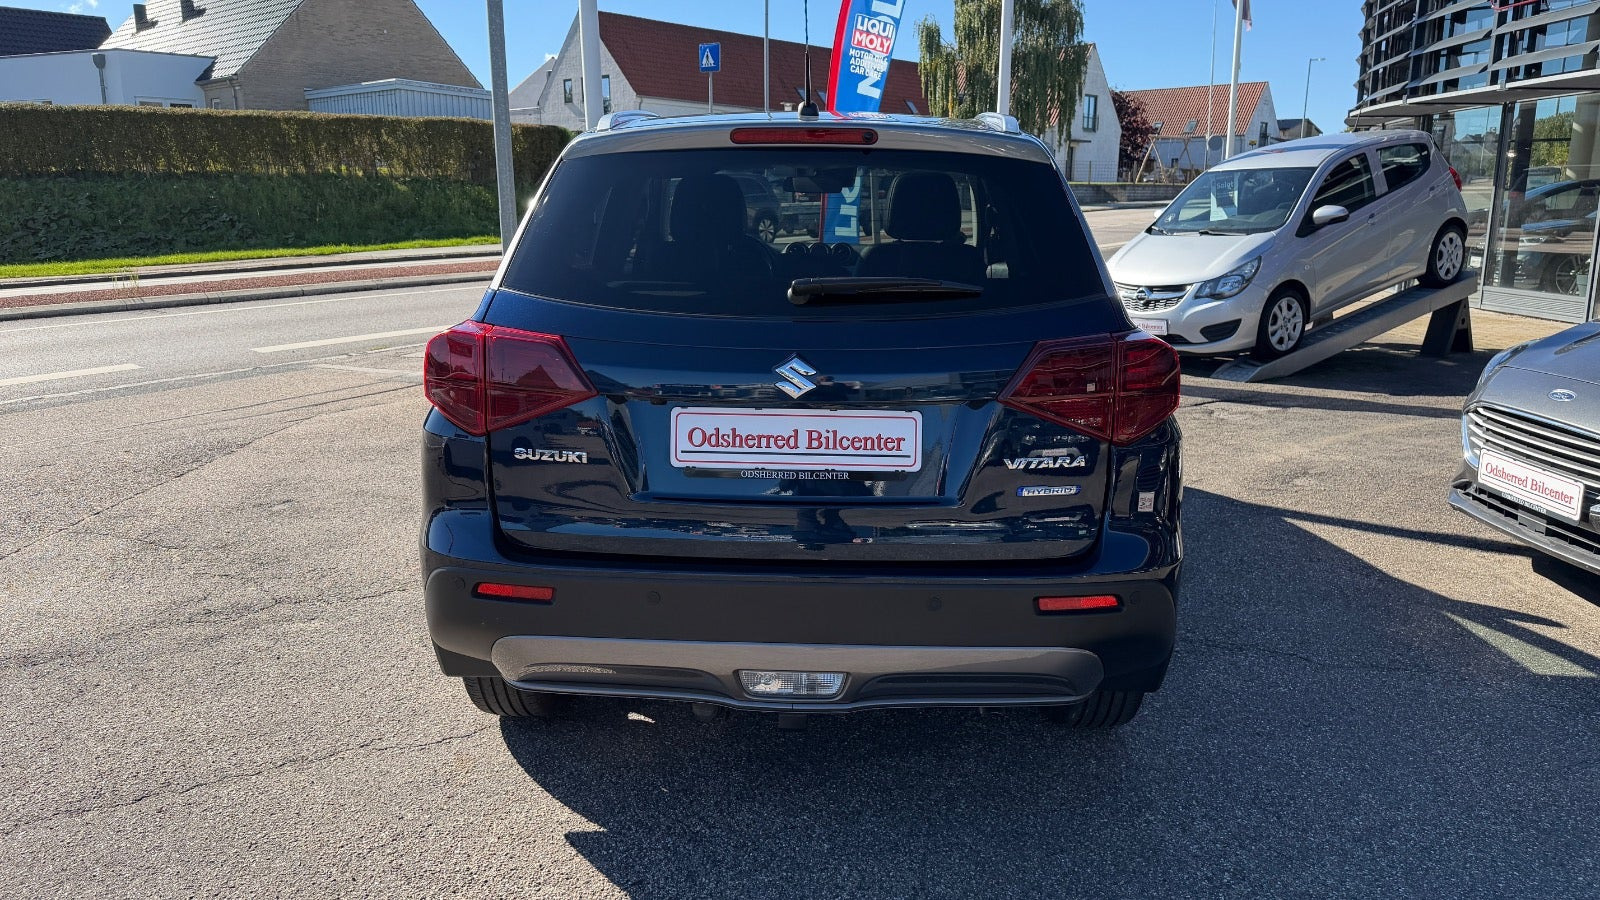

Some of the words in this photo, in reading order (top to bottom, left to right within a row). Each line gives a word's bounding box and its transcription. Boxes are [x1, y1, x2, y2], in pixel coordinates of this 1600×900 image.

[856, 15, 895, 38] LIQUI
[853, 31, 892, 53] MOLY
[849, 48, 874, 60] MOTOR
[850, 65, 865, 76] CAR
[687, 427, 800, 450] Odsherred
[806, 429, 906, 451] Bilcenter
[513, 447, 588, 464] SUZUKI
[1003, 455, 1086, 470] VITARA
[740, 470, 797, 480] ODSHERRED
[798, 471, 850, 480] BILCENTER
[1025, 487, 1074, 496] HYBRID
[1485, 462, 1529, 487] Odsherred
[1529, 477, 1574, 505] Bilcenter
